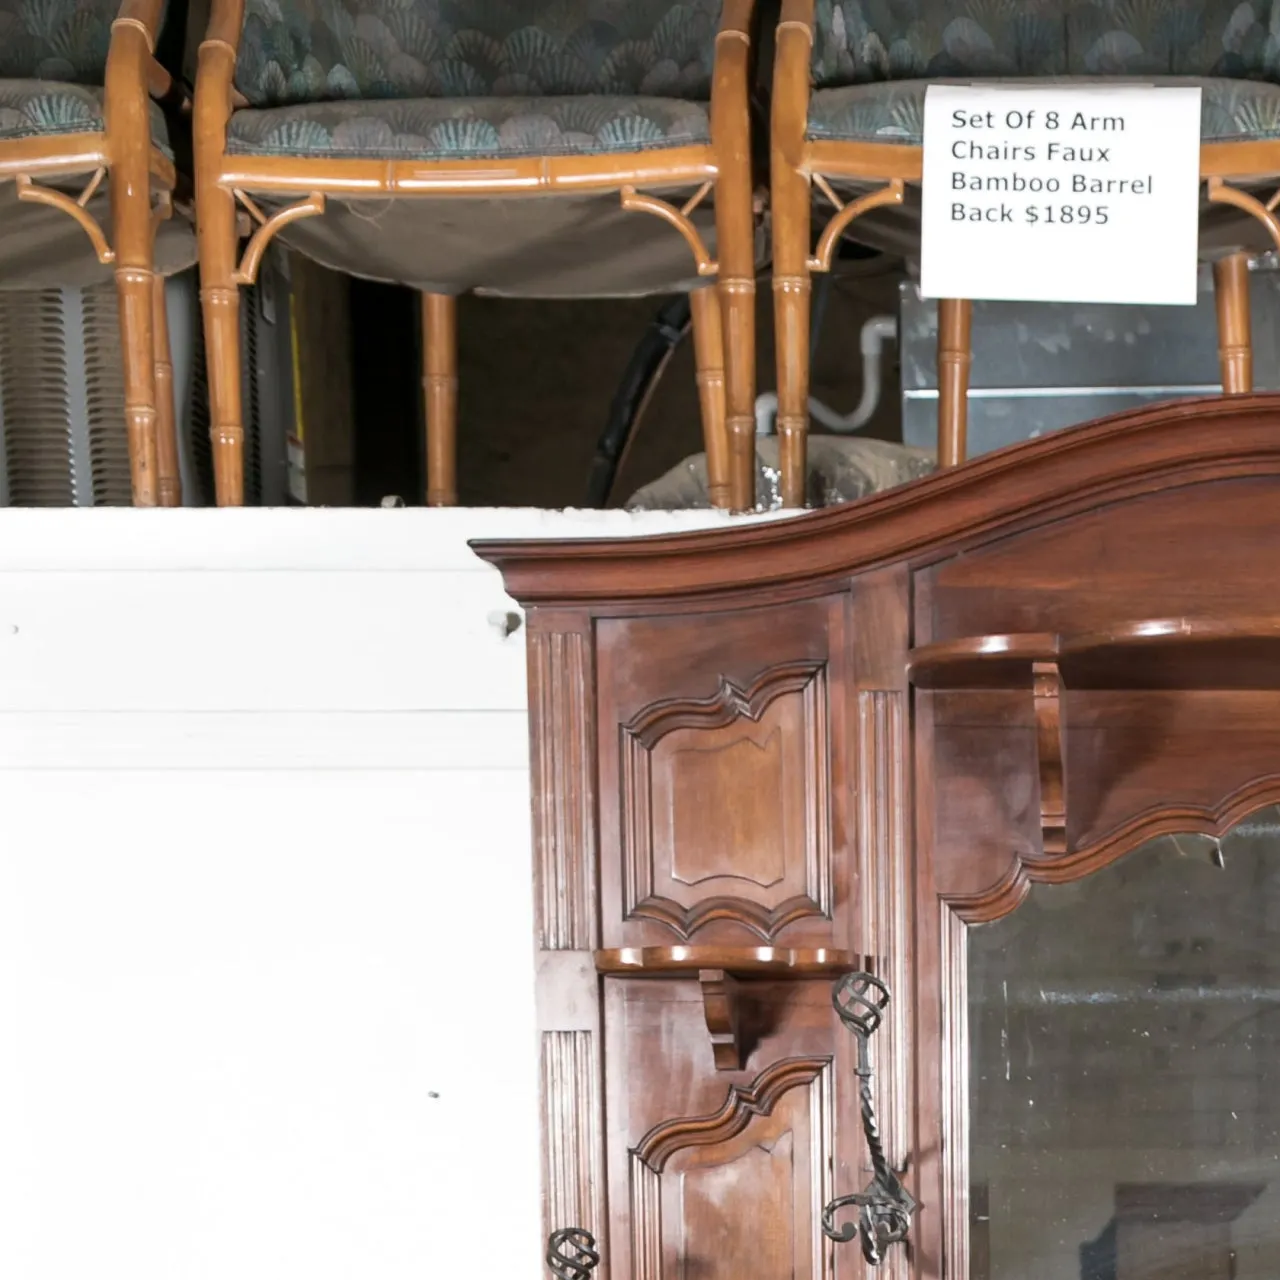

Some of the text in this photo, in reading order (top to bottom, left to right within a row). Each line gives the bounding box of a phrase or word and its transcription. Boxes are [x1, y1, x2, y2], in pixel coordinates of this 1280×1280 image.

[952, 110, 1125, 131] Set Of 8 Arm
[951, 141, 1110, 162] Chairs Faux
[952, 172, 1152, 194] Bamboo Barrel
[951, 203, 1109, 227] Back $1895
